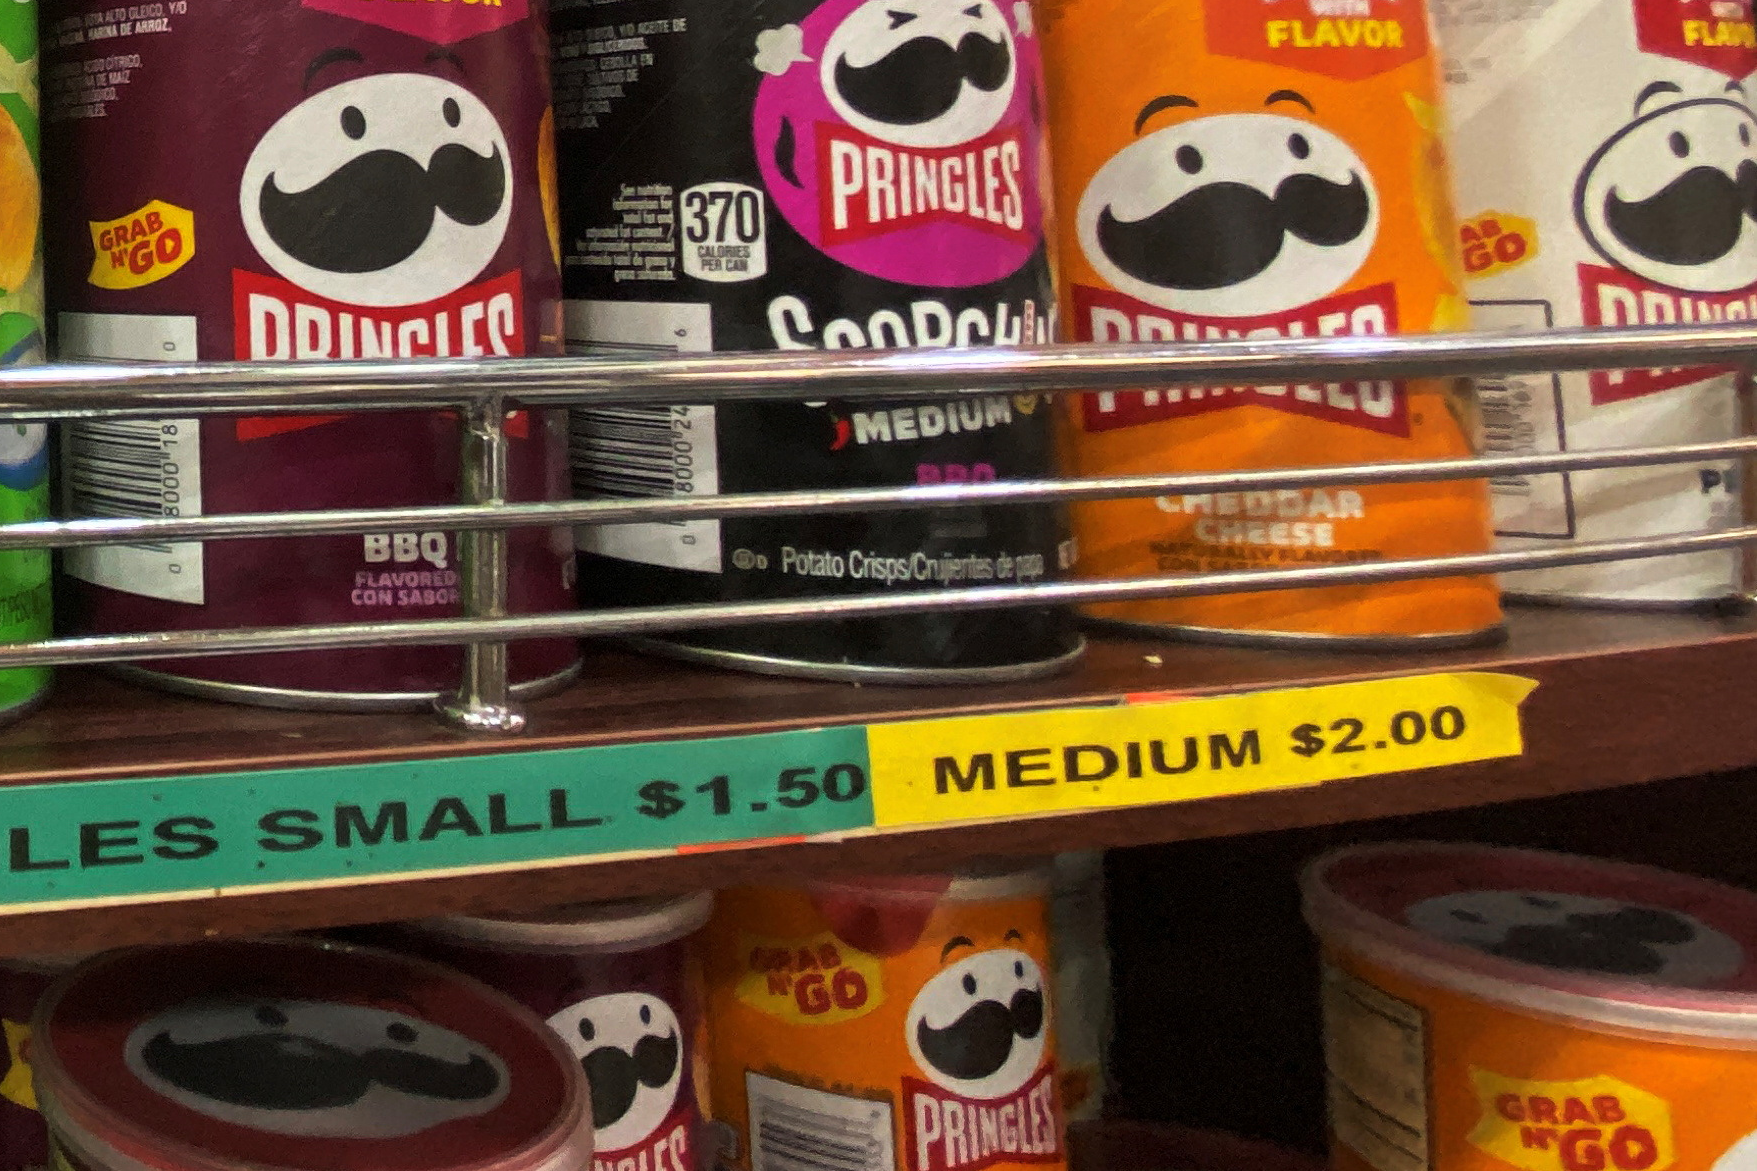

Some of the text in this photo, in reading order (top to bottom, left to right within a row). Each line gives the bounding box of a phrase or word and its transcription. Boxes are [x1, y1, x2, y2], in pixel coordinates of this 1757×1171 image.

[1265, 20, 1403, 49] FLAVOR
[830, 140, 1022, 231] PRINGLES
[99, 211, 163, 252] GRAB
[685, 191, 760, 243] 370
[128, 227, 181, 276] GO
[698, 245, 750, 258] CALORIES
[701, 259, 748, 271] PER CAN
[1462, 232, 1526, 274] GO
[852, 398, 1013, 445] MEDIUM
[1155, 489, 1364, 518] CHEDDAR
[364, 533, 448, 568] BBQ
[1195, 518, 1333, 547] CHEESE
[782, 547, 844, 577] Potato
[351, 589, 393, 606] CON
[933, 705, 1466, 794] MEDIUM $2.00
[257, 787, 605, 856] SMALL
[637, 760, 866, 824] $1.50
[794, 966, 869, 1016] GO
[914, 1075, 1057, 1171] PRINGLES
[1495, 1093, 1627, 1126] GRAB
[1557, 1125, 1658, 1171] GO
